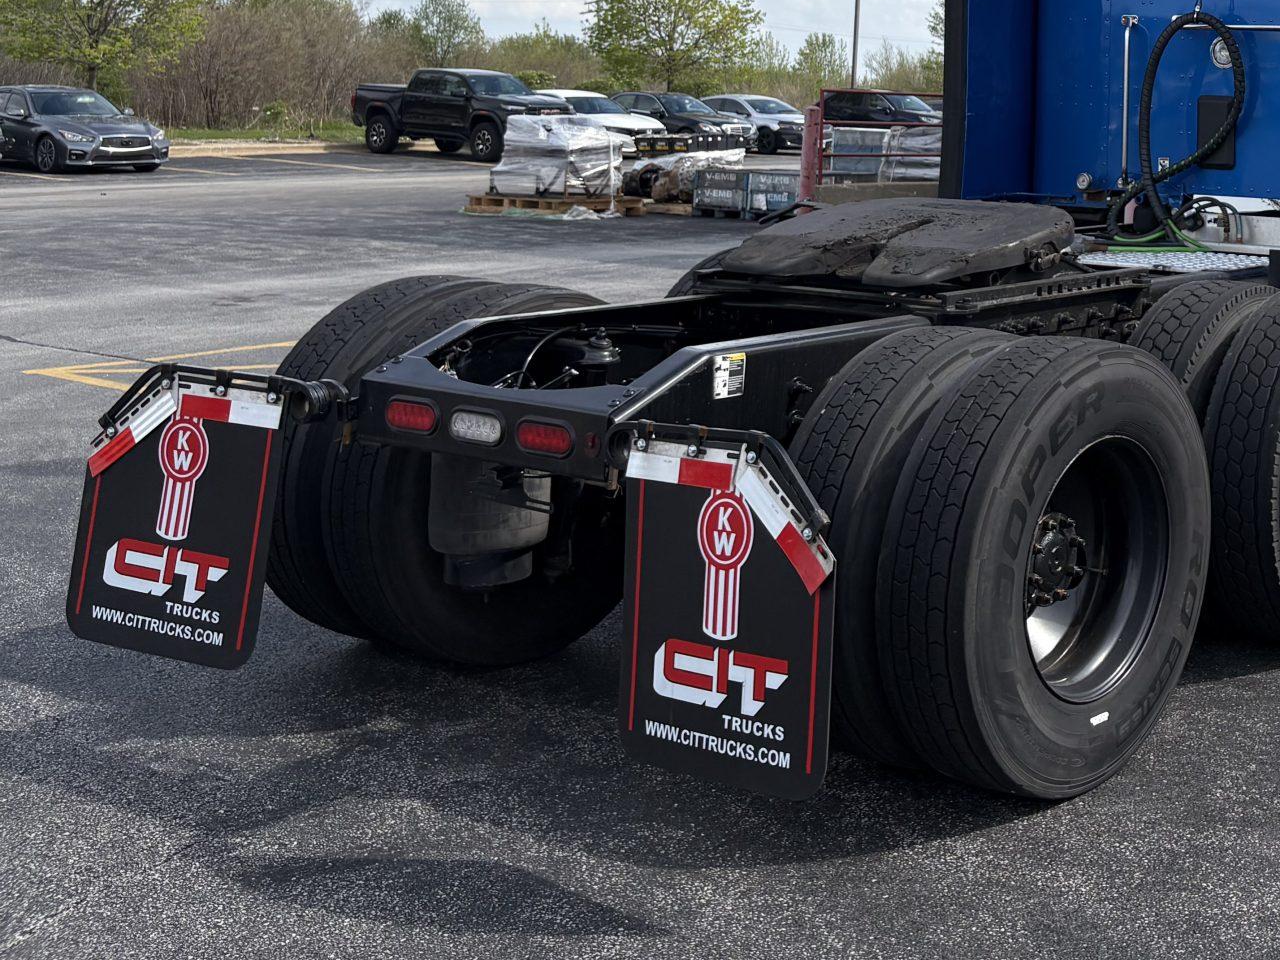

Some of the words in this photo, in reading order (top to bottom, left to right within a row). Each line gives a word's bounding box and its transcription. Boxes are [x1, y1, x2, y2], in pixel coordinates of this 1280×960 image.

[108, 537, 230, 596] CIT
[92, 605, 224, 647] WWW.CITTRUCKS.COM
[165, 601, 220, 624] TRUCKS
[658, 638, 789, 705] CIT
[644, 719, 791, 770] WWW.CITTRUCKS.COM
[722, 714, 785, 741] TRUCKS
